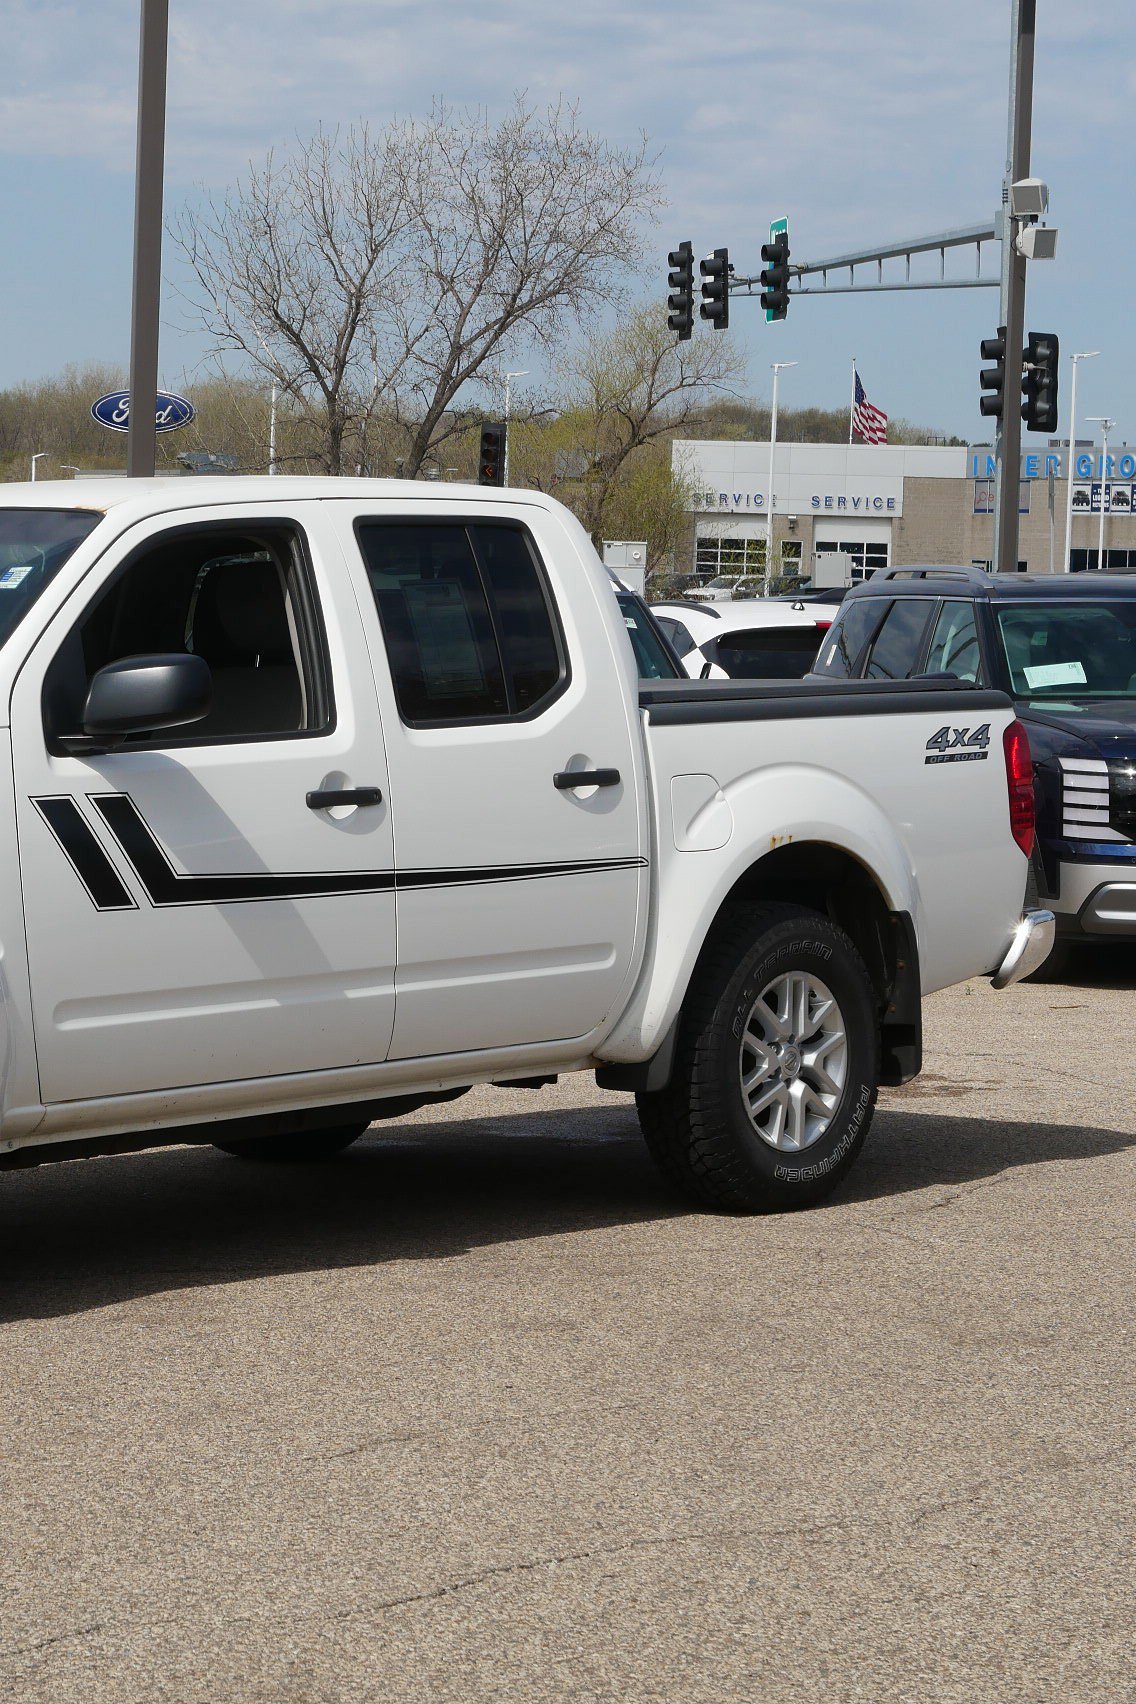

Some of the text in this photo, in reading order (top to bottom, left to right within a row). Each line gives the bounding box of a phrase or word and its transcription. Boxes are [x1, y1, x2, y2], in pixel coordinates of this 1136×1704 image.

[112, 397, 172, 424] Fd
[973, 454, 1061, 478] INER
[811, 495, 895, 509] SERVICE
[929, 752, 983, 764] OFF ROAD
[753, 940, 833, 982] TERRAIN
[774, 1084, 871, 1182] PATHFINDER
